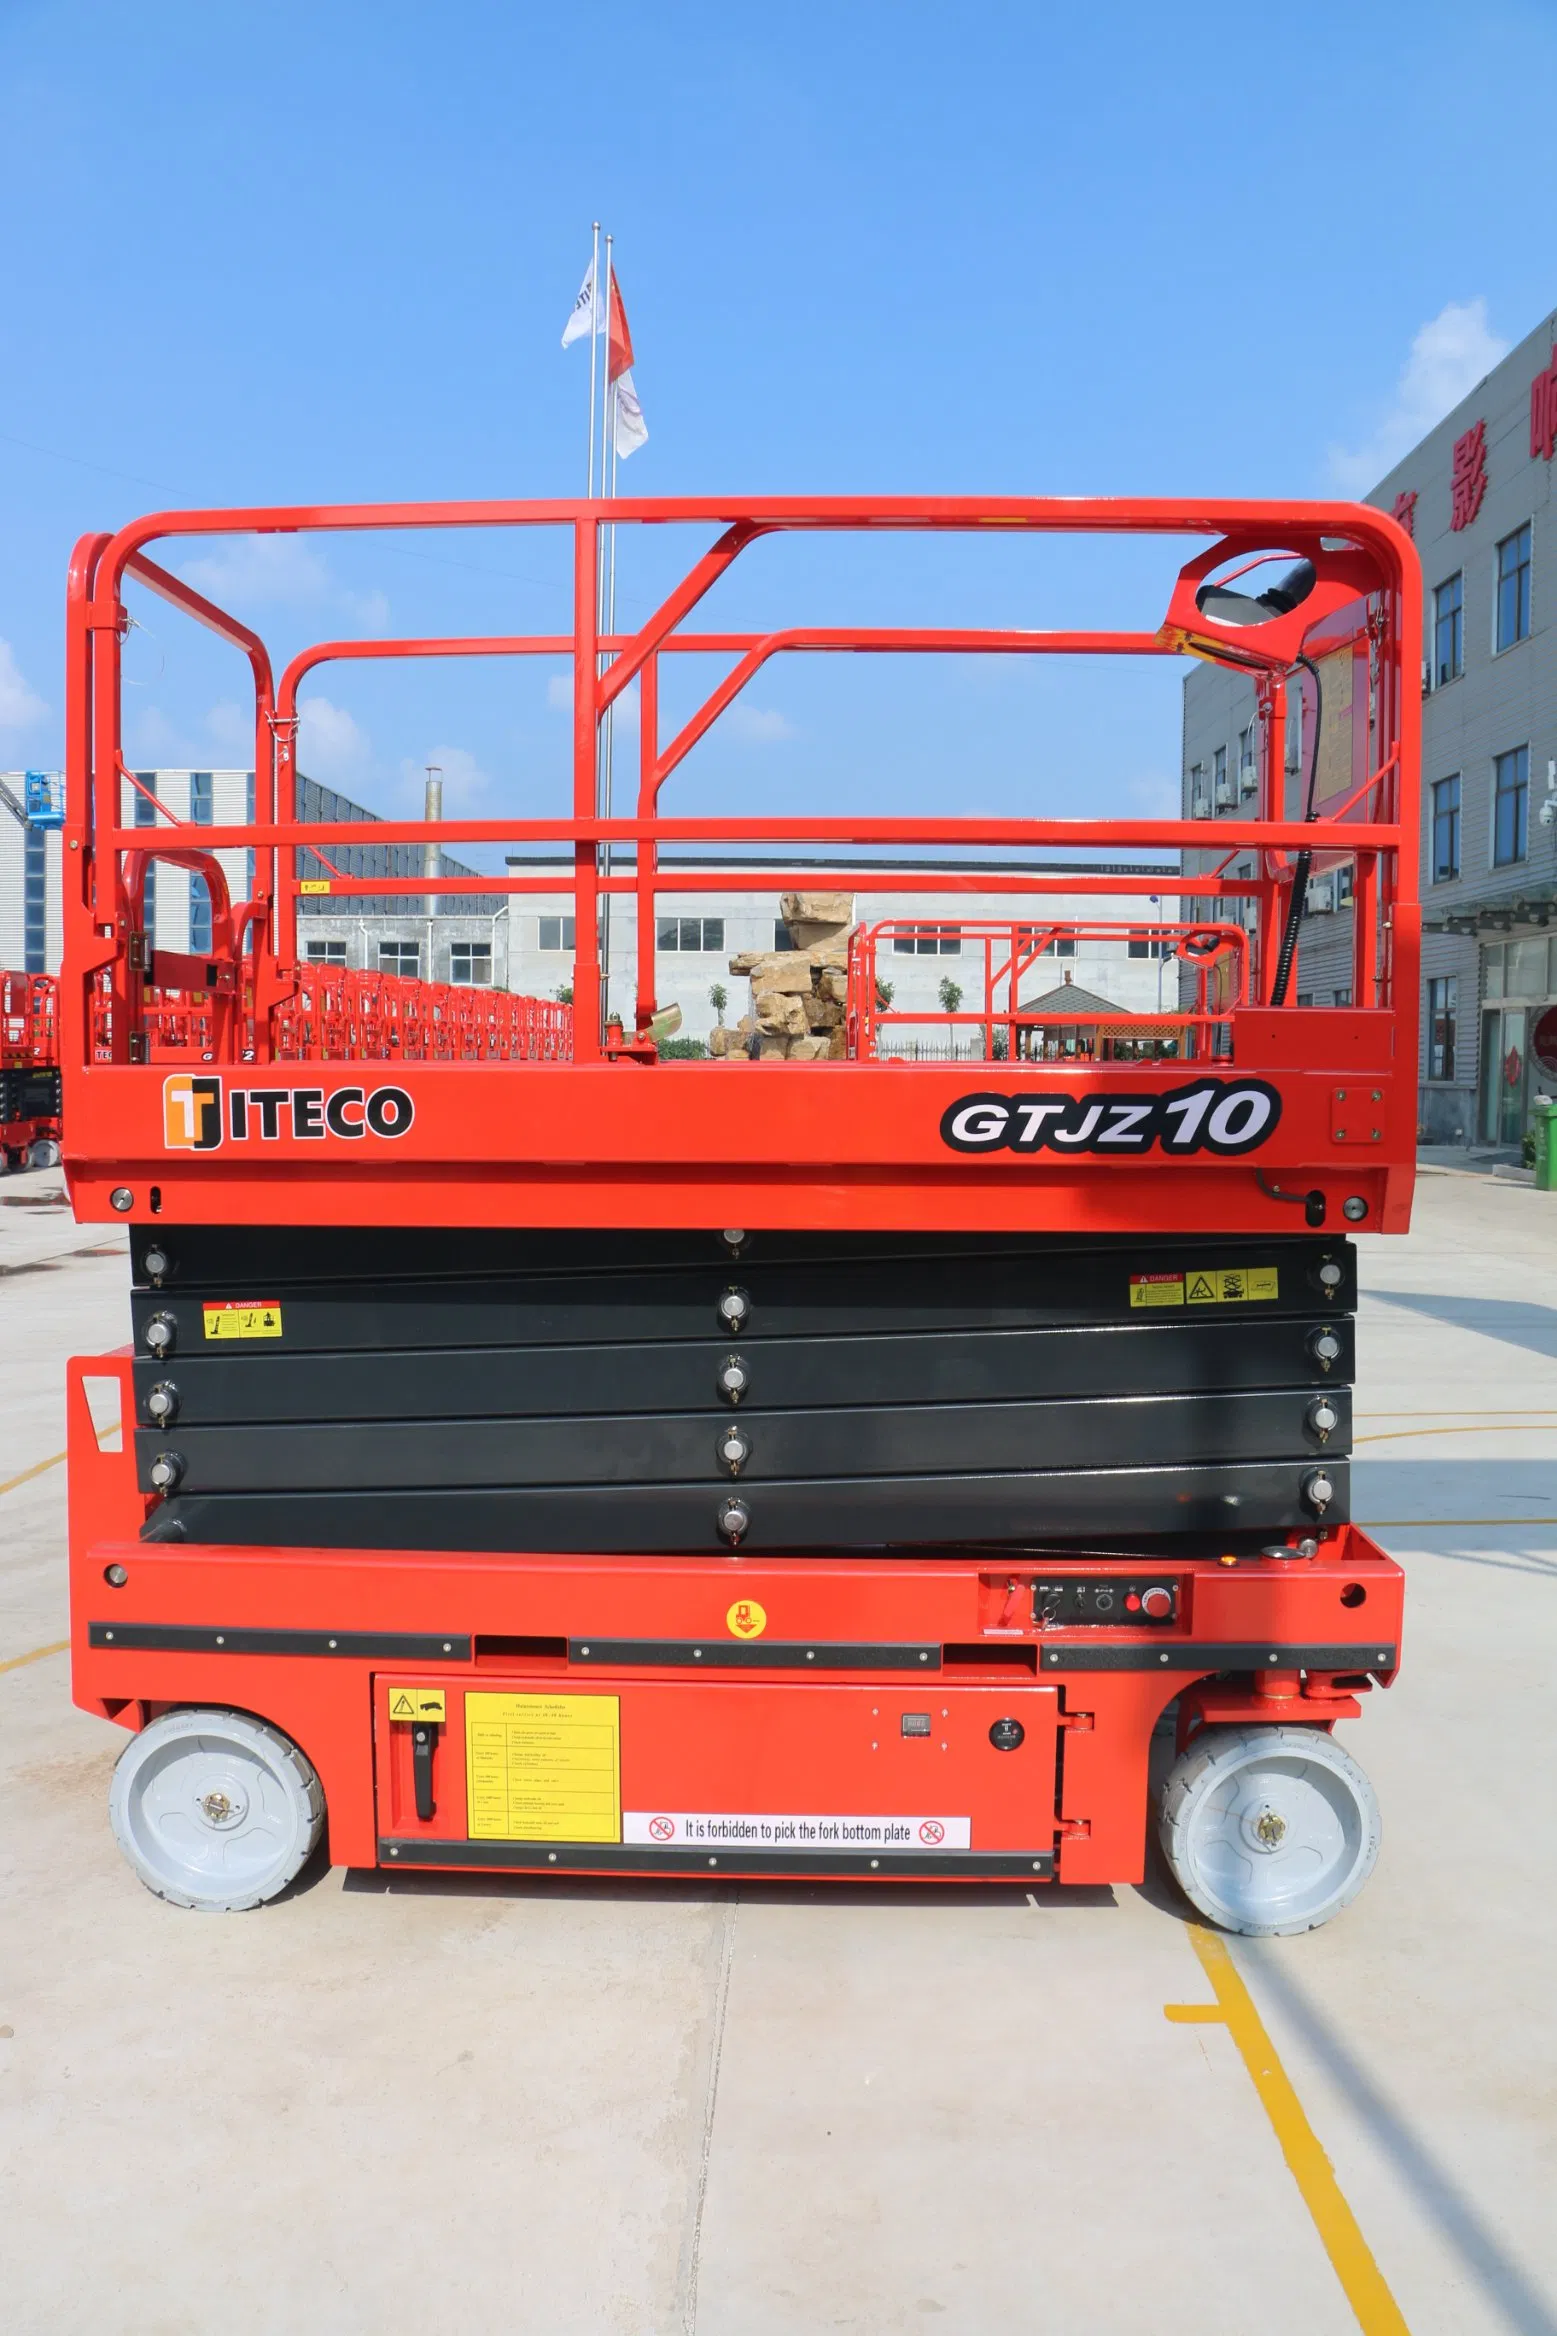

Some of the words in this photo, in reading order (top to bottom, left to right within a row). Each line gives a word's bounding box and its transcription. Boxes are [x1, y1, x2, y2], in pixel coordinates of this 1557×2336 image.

[229, 1086, 415, 1140] ITECO
[1149, 1274, 1178, 1282] DANGER
[686, 1820, 693, 1837] It
[696, 1820, 705, 1838] is
[707, 1820, 758, 1839] forbidden
[761, 1823, 772, 1839] to
[774, 1821, 796, 1843] pick
[799, 1822, 816, 1840] the
[819, 1822, 839, 1840] fork
[842, 1822, 881, 1841] bottom
[884, 1823, 911, 1844] plate
